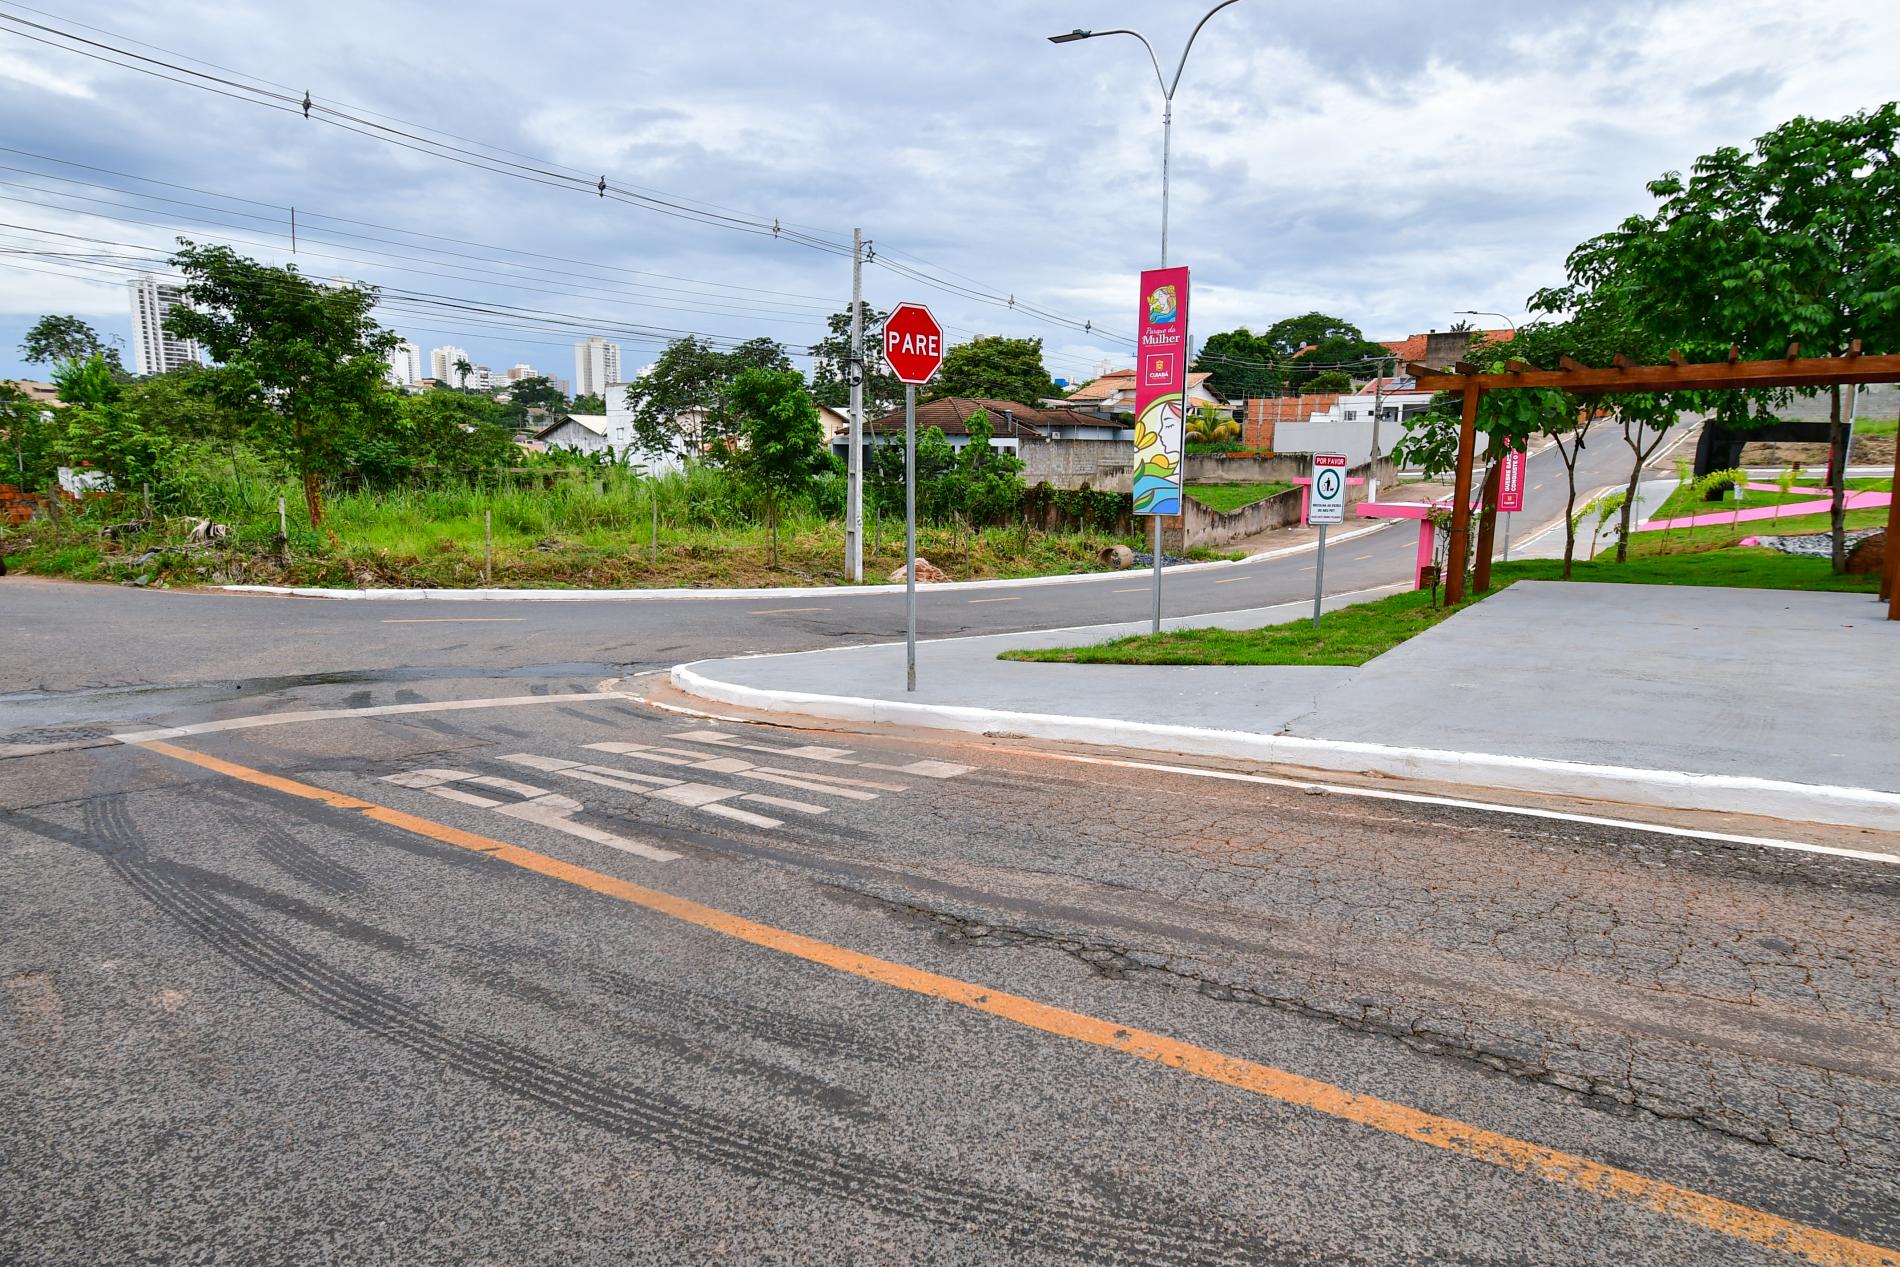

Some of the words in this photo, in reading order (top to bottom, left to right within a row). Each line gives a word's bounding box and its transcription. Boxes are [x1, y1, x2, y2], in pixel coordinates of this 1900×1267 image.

[1146, 327, 1167, 335] Parque
[1167, 325, 1176, 333] da
[888, 331, 939, 357] PARE
[1142, 334, 1180, 344] Mulher
[1316, 457, 1327, 465] POR
[1327, 457, 1345, 466] FAVOR
[378, 730, 979, 863] PARE
